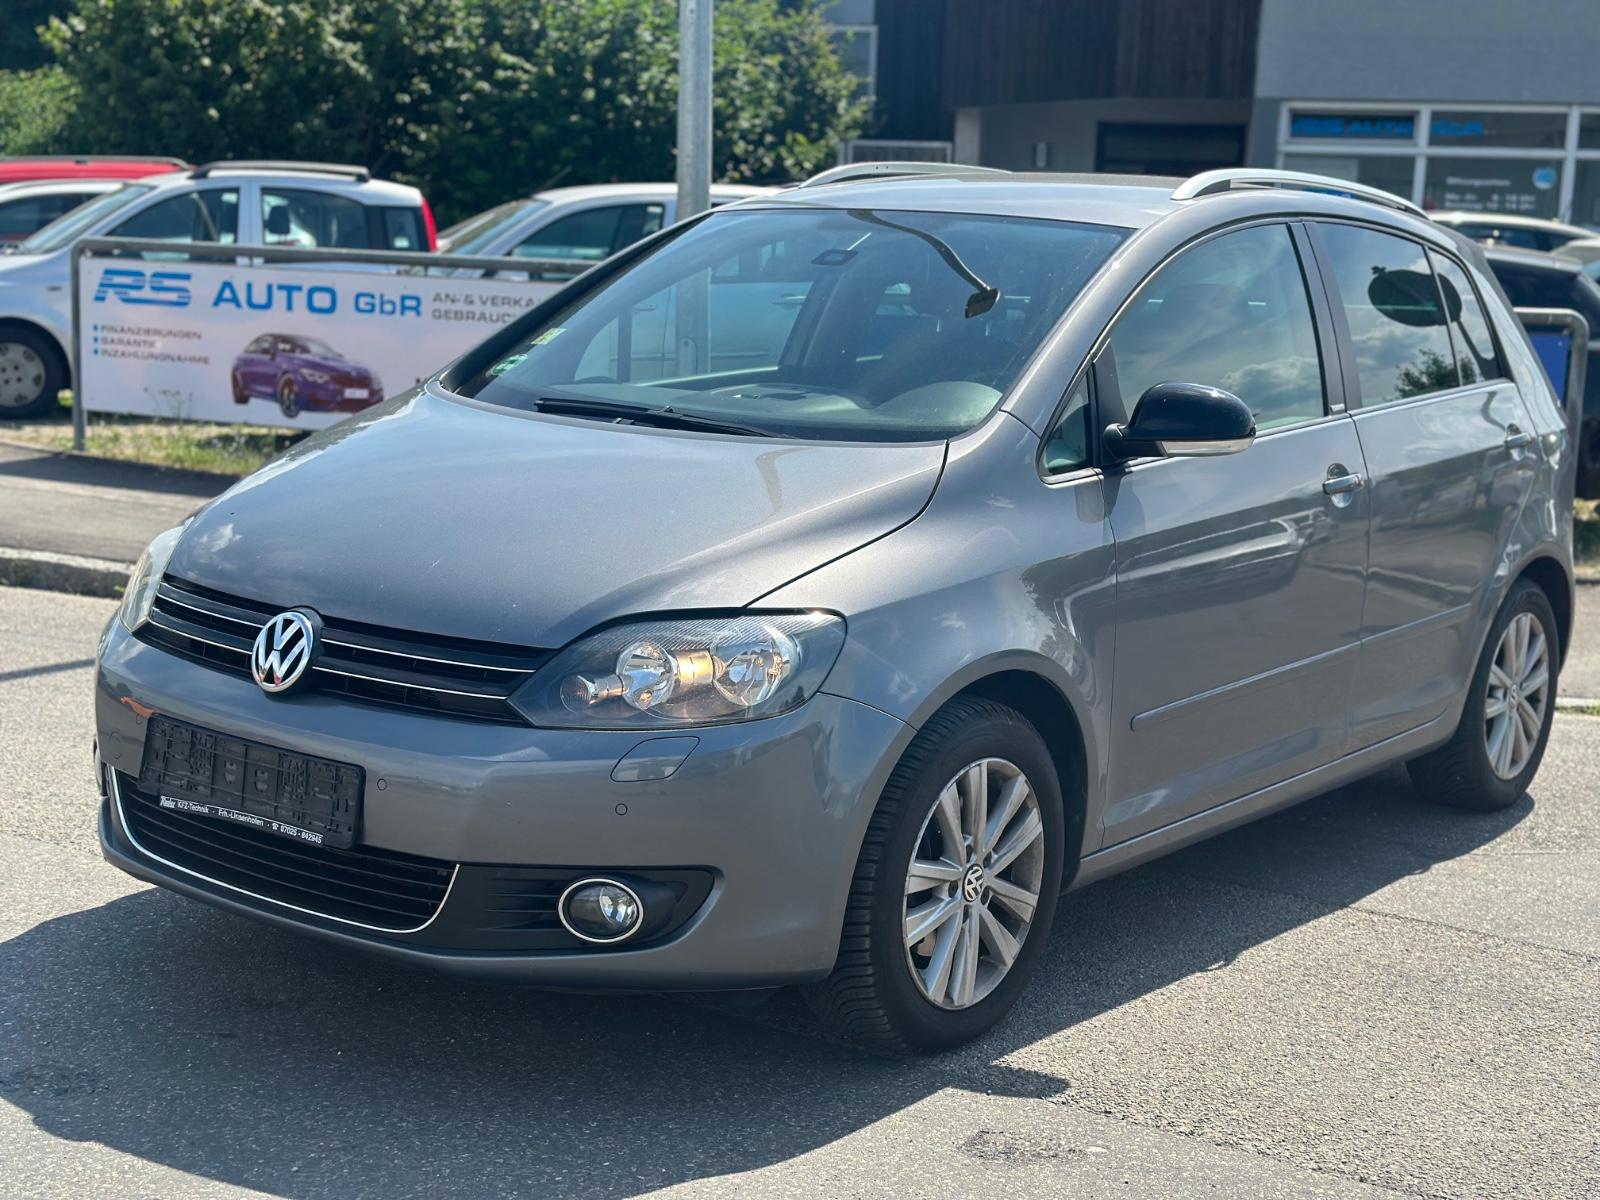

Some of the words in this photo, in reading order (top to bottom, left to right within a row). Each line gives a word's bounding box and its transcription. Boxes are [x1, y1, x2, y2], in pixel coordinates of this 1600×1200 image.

[94, 269, 192, 307] RS
[212, 280, 337, 314] AUTO
[354, 292, 422, 317] GbR
[479, 294, 541, 308] VERKA
[431, 308, 517, 324] GEBRAUC
[101, 324, 202, 340] FINANZIERUNGEN
